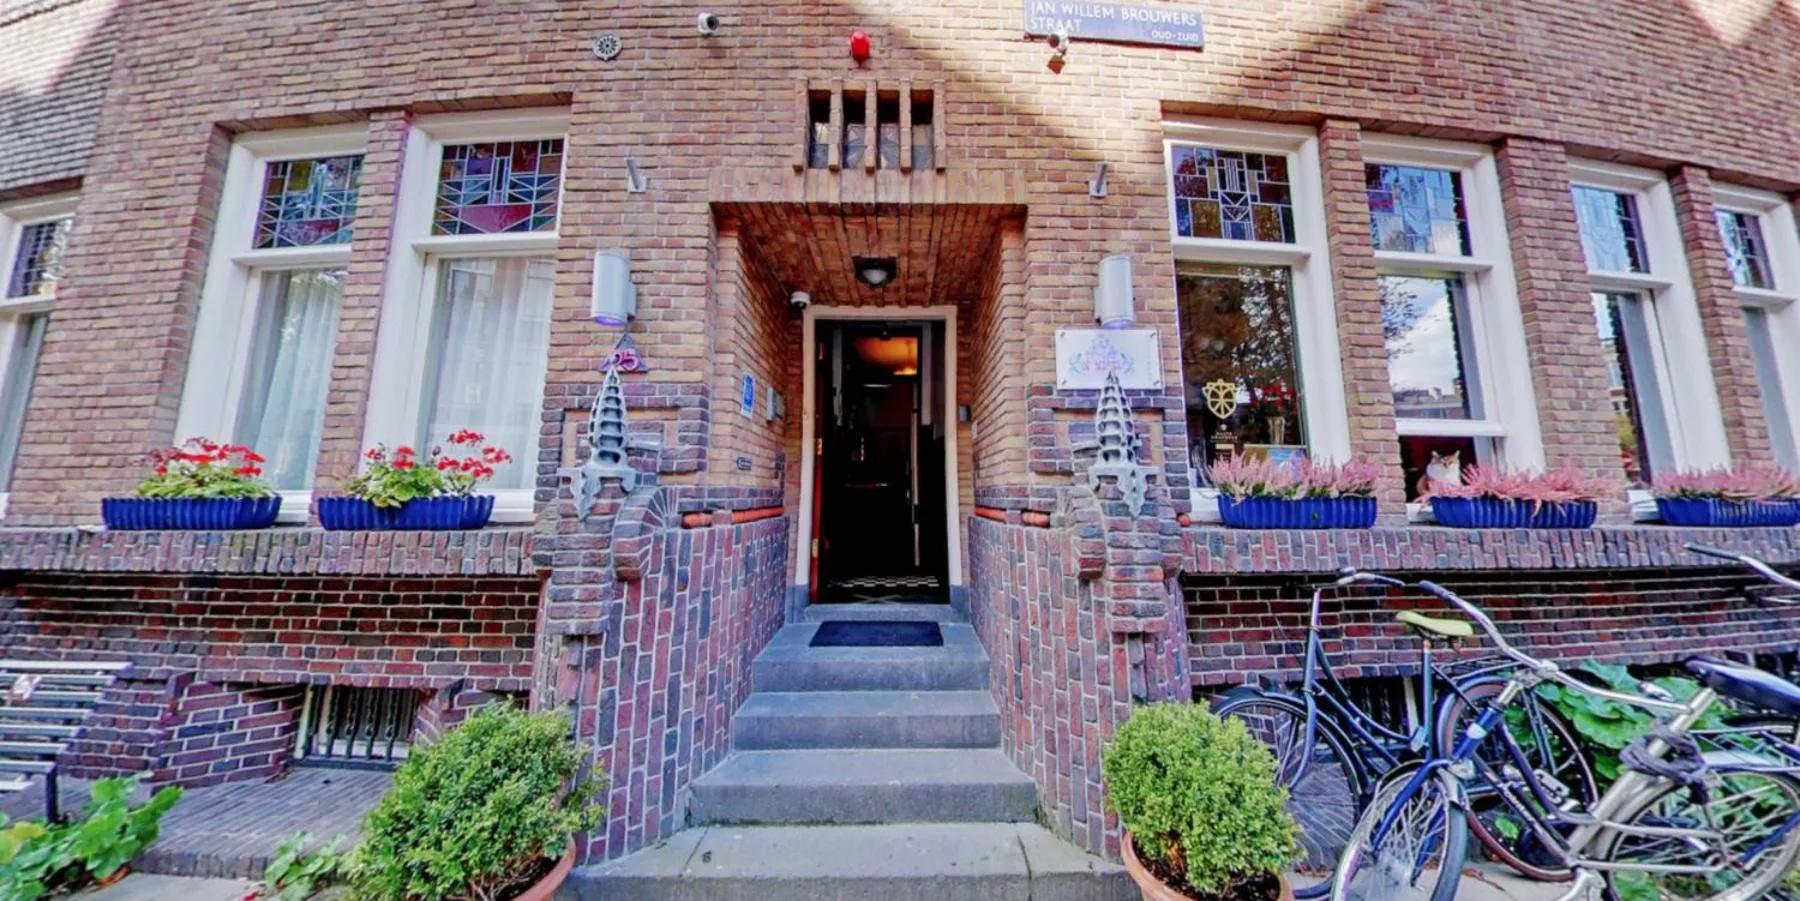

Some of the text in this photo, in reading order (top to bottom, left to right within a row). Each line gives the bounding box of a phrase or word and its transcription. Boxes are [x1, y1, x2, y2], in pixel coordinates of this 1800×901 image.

[1031, 1, 1197, 26] JAN WILLEM BROUWERS
[1031, 17, 1082, 32] STRAAT
